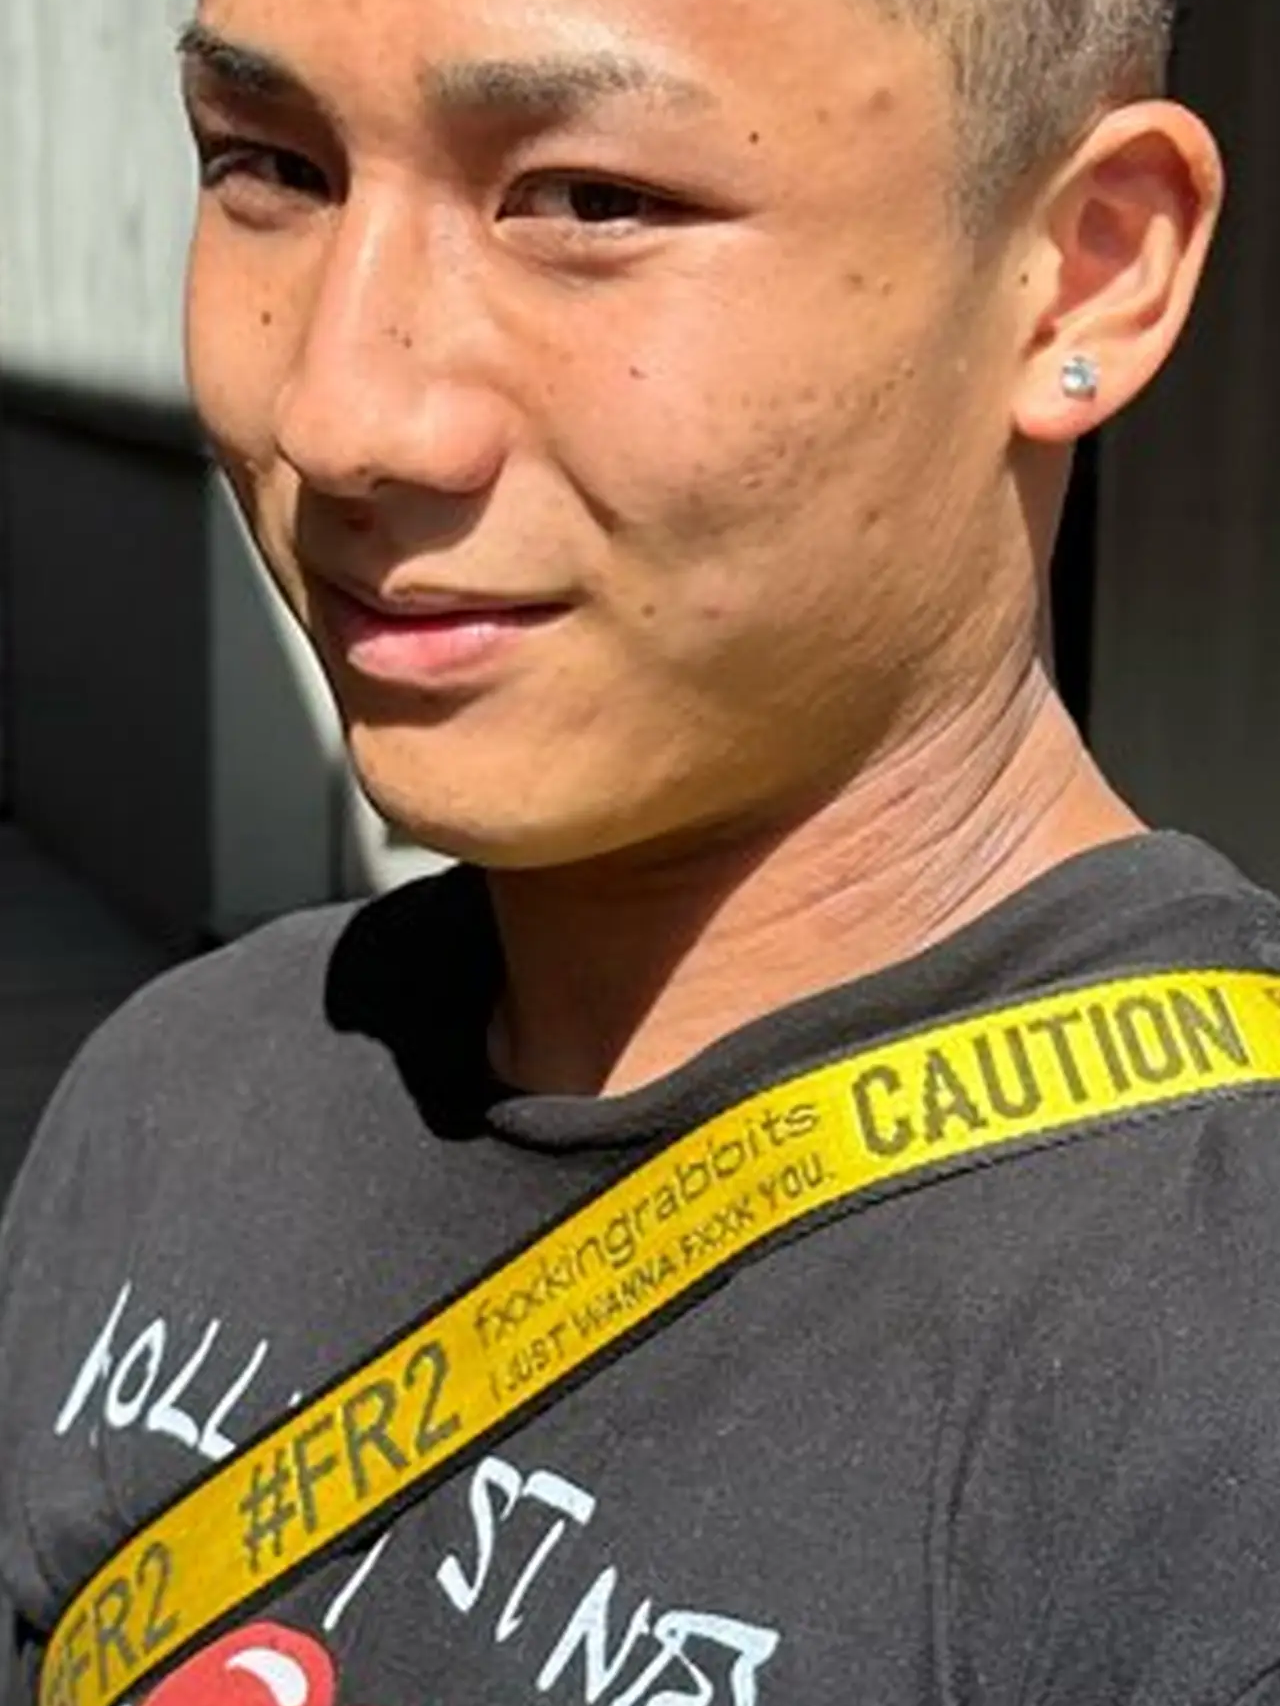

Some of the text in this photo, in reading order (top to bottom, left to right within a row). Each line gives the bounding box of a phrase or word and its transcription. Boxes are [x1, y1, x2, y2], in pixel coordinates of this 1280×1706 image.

[851, 985, 1250, 1159] CAUTION
[569, 1250, 678, 1340] WANNA
[238, 1342, 463, 1574] #FR2
